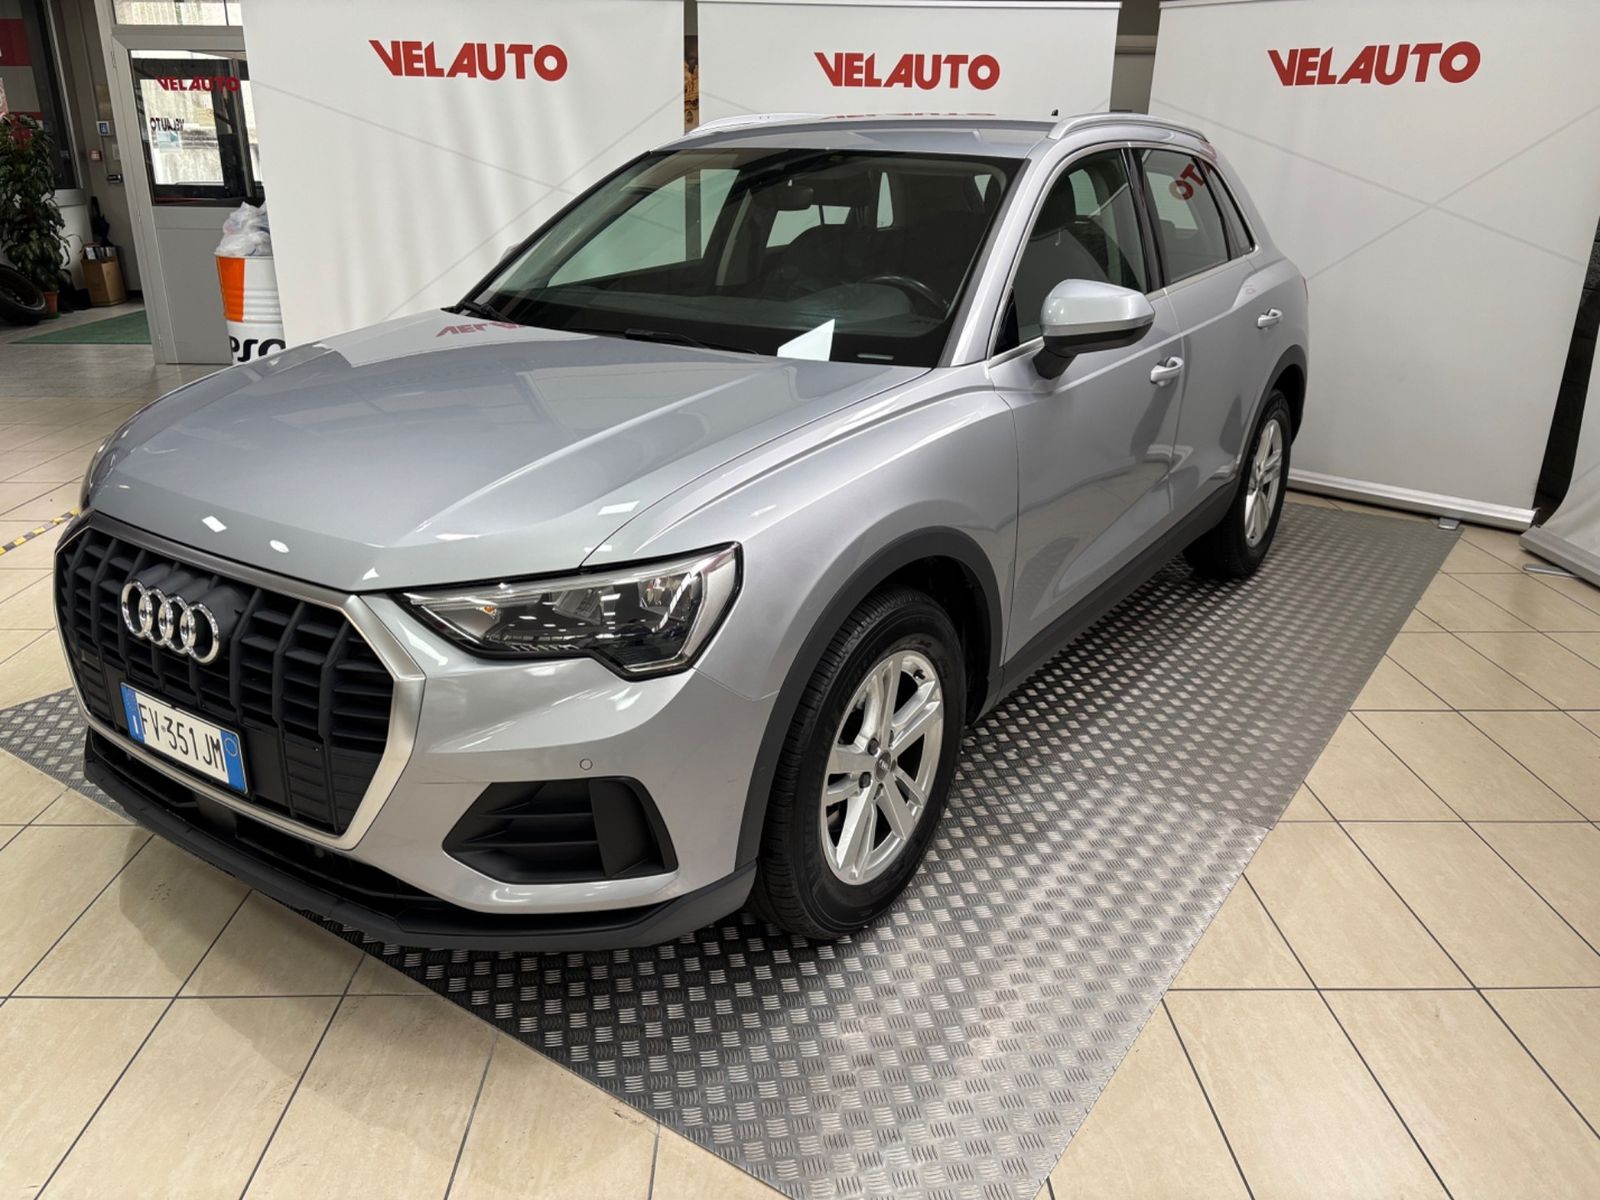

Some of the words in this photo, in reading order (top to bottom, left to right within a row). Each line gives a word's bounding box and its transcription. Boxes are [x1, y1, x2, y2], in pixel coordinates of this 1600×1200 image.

[368, 40, 568, 81] VELAUTO
[814, 52, 1000, 90] VELAUTO
[1267, 41, 1481, 87] VELAUTO
[154, 75, 240, 92] VELAUTO
